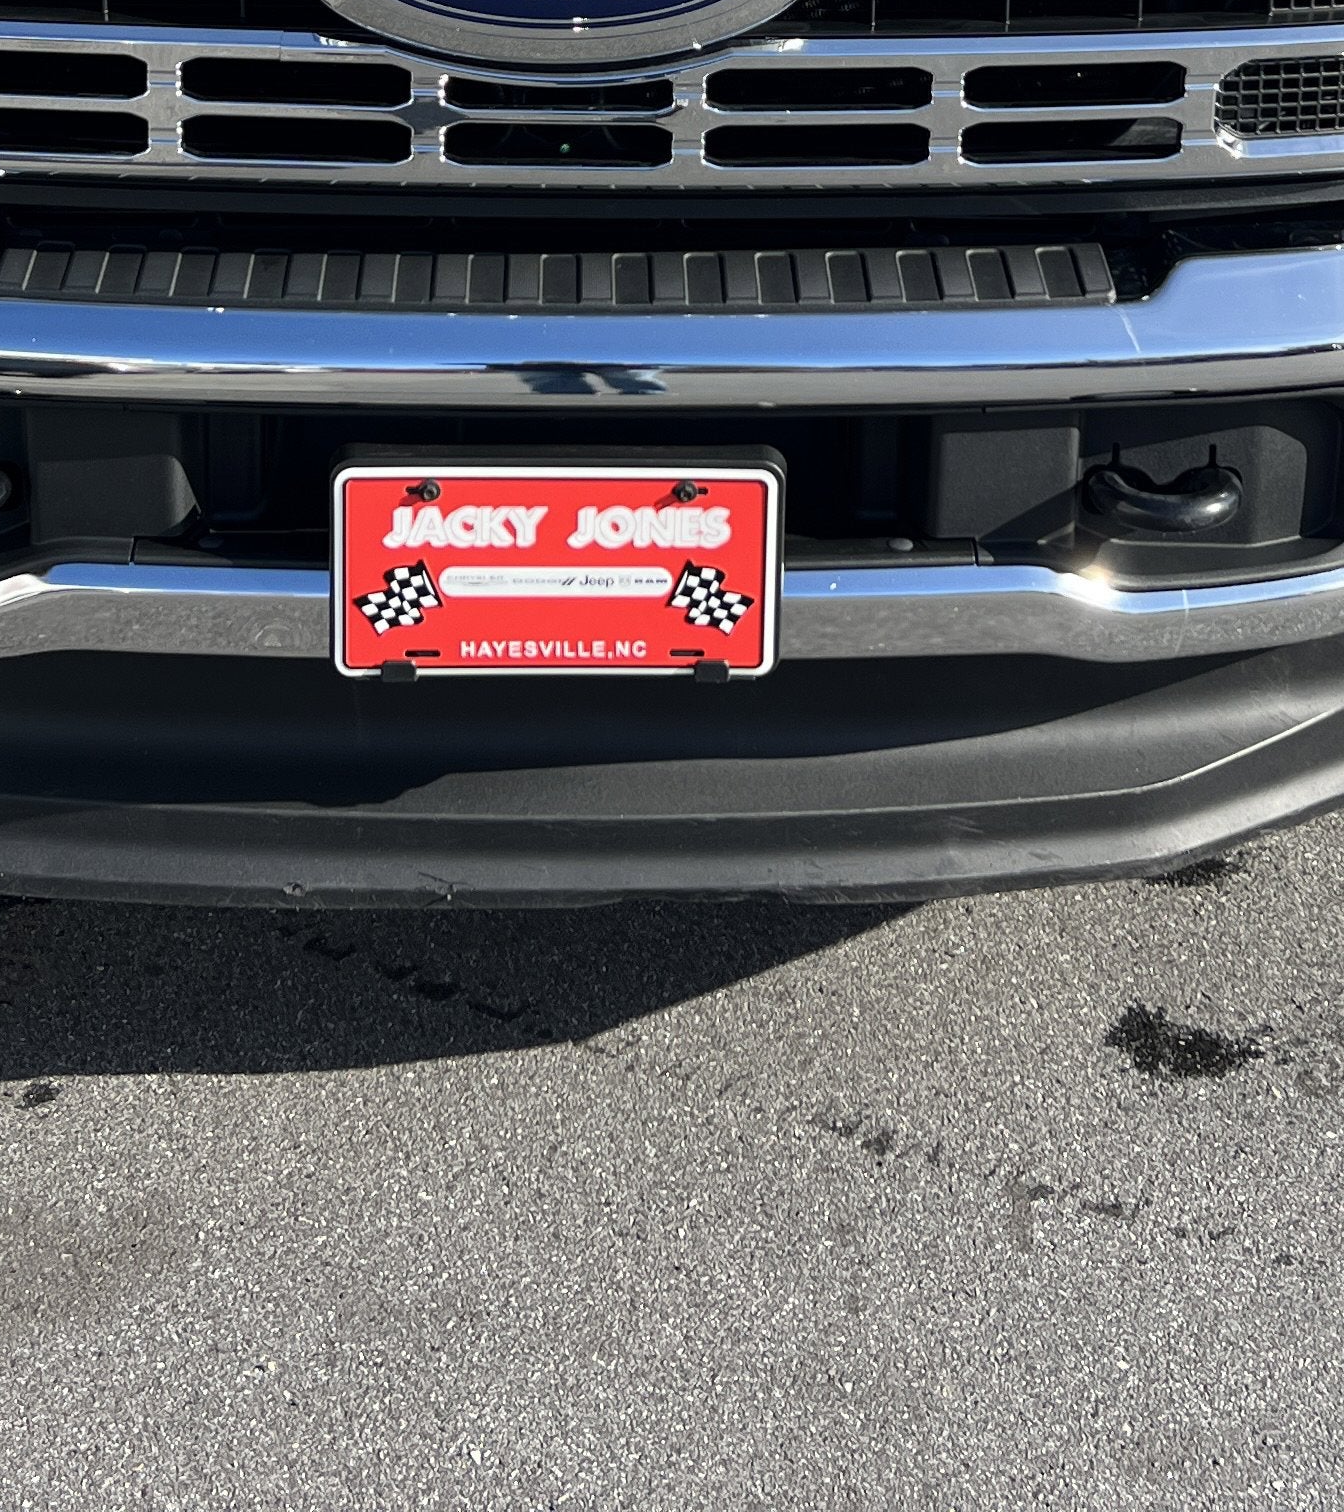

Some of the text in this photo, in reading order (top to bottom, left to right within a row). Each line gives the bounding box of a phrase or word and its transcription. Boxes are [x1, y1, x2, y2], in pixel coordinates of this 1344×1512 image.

[382, 505, 732, 550] JACKY JONES
[578, 573, 615, 588] Jeep
